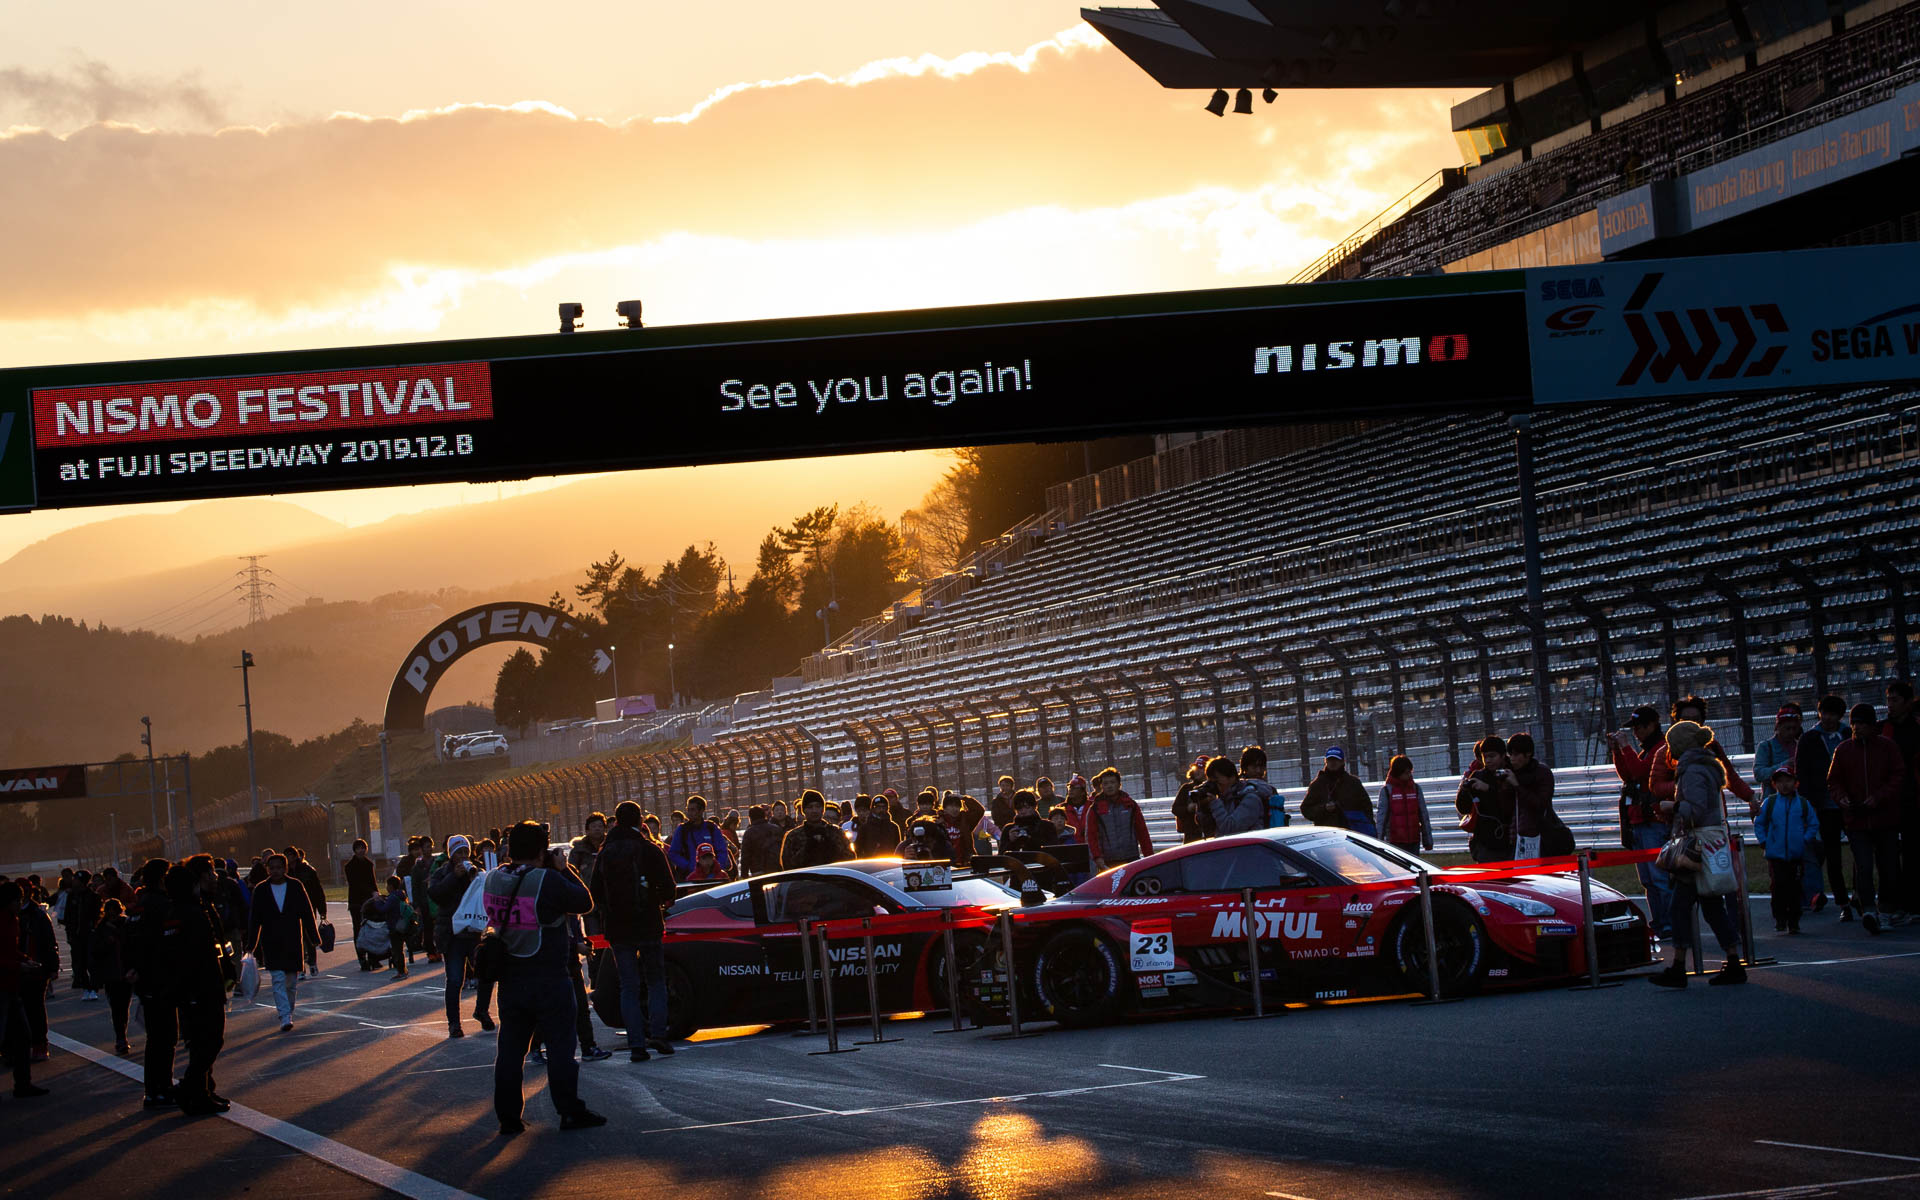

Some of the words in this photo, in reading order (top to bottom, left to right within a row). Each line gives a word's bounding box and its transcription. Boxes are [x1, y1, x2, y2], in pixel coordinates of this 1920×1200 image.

[1792, 138, 1838, 180] Honda
[1840, 120, 1891, 158] Racing
[1696, 176, 1737, 214] Honda
[1739, 159, 1785, 194] Racing
[1603, 202, 1649, 239] HONDA
[1541, 277, 1605, 300] SEGA
[1254, 333, 1470, 375] nismo
[1811, 326, 1894, 361] SEGA
[720, 378, 798, 411] See
[807, 375, 889, 415] you
[903, 359, 1032, 407] again!
[56, 392, 222, 436] NISMO
[237, 376, 472, 425] FESTIVAL
[59, 459, 90, 481] at
[98, 454, 161, 479] FUJI
[169, 443, 333, 475] SPEEDWAY
[341, 433, 474, 463] 2019.12.8
[490, 895, 520, 907] MEDA
[1342, 902, 1373, 912] Jatco
[1210, 911, 1324, 939] MOTUL
[828, 943, 902, 962] NISSAN
[1135, 934, 1168, 955] 23
[1288, 946, 1341, 960] TAMADIC
[718, 964, 761, 976] NISSAN
[839, 962, 901, 977] MOBLITY
[1137, 975, 1161, 985] NGK
[1488, 968, 1509, 977] BBS
